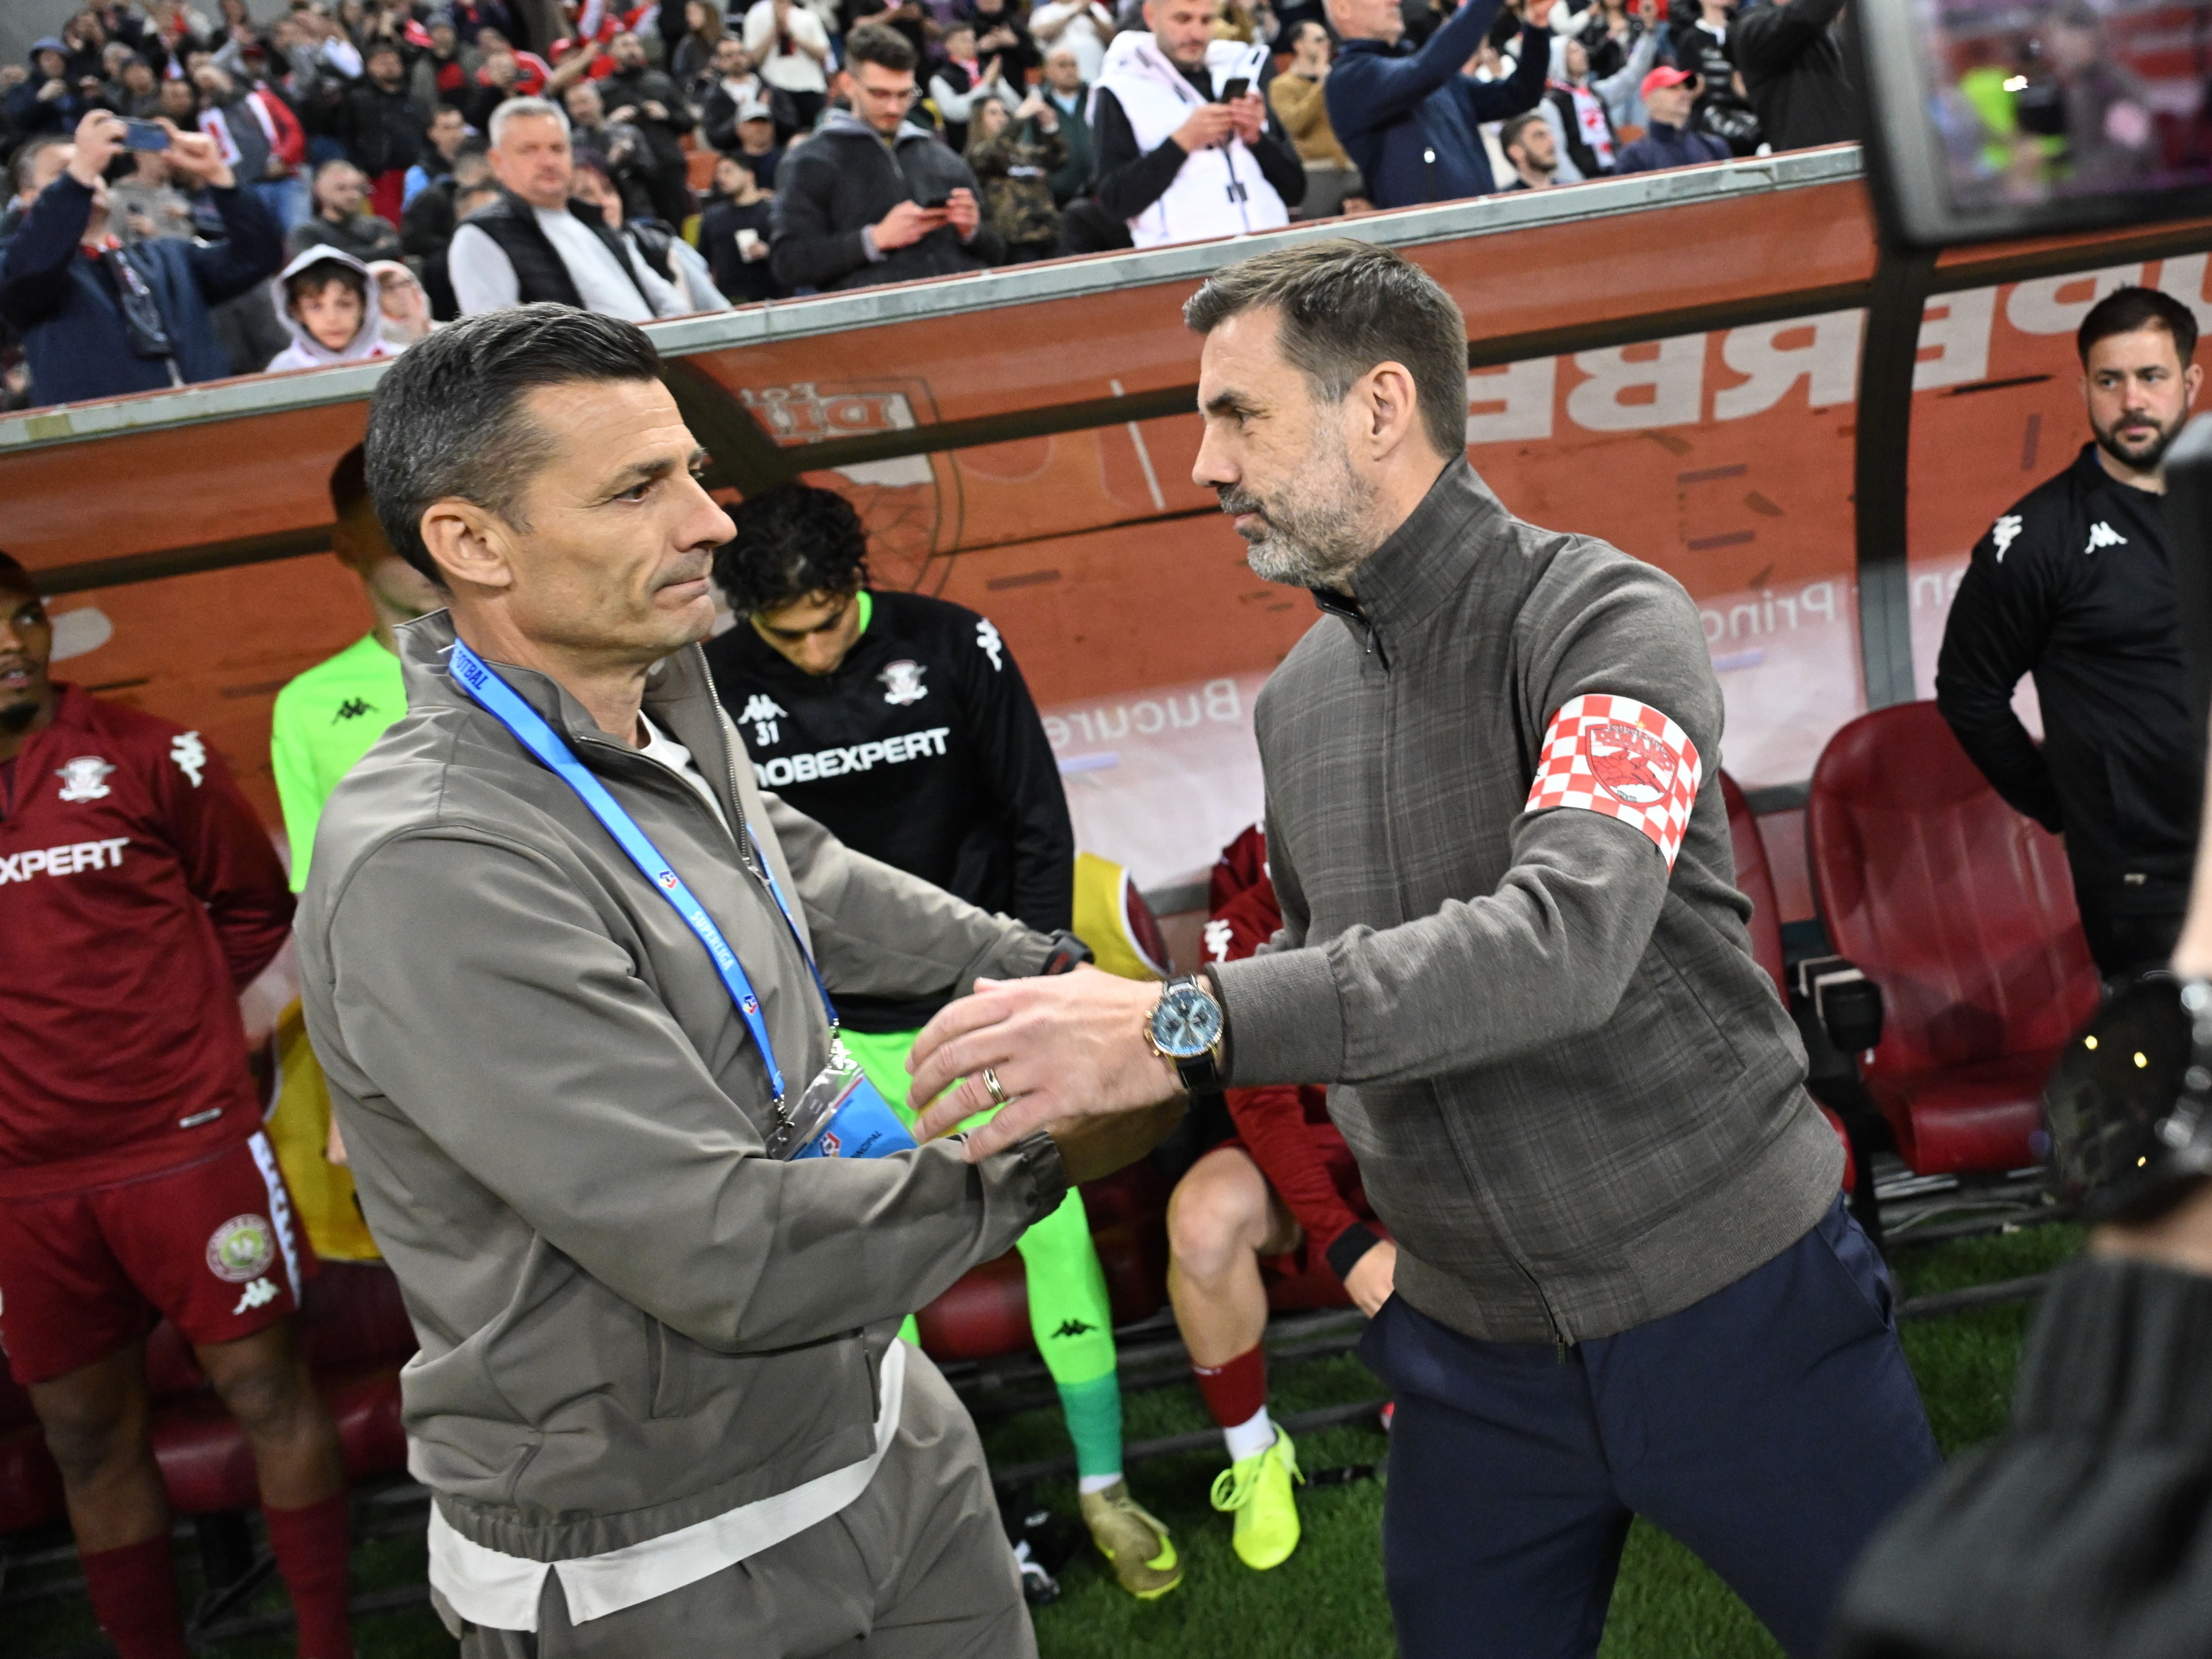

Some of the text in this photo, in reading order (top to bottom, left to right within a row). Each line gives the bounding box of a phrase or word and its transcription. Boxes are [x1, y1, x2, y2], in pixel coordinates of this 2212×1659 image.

[755, 721, 780, 747] 31
[1594, 729, 1673, 772] DINAMO
[690, 910, 734, 971] SUPERLIGA
